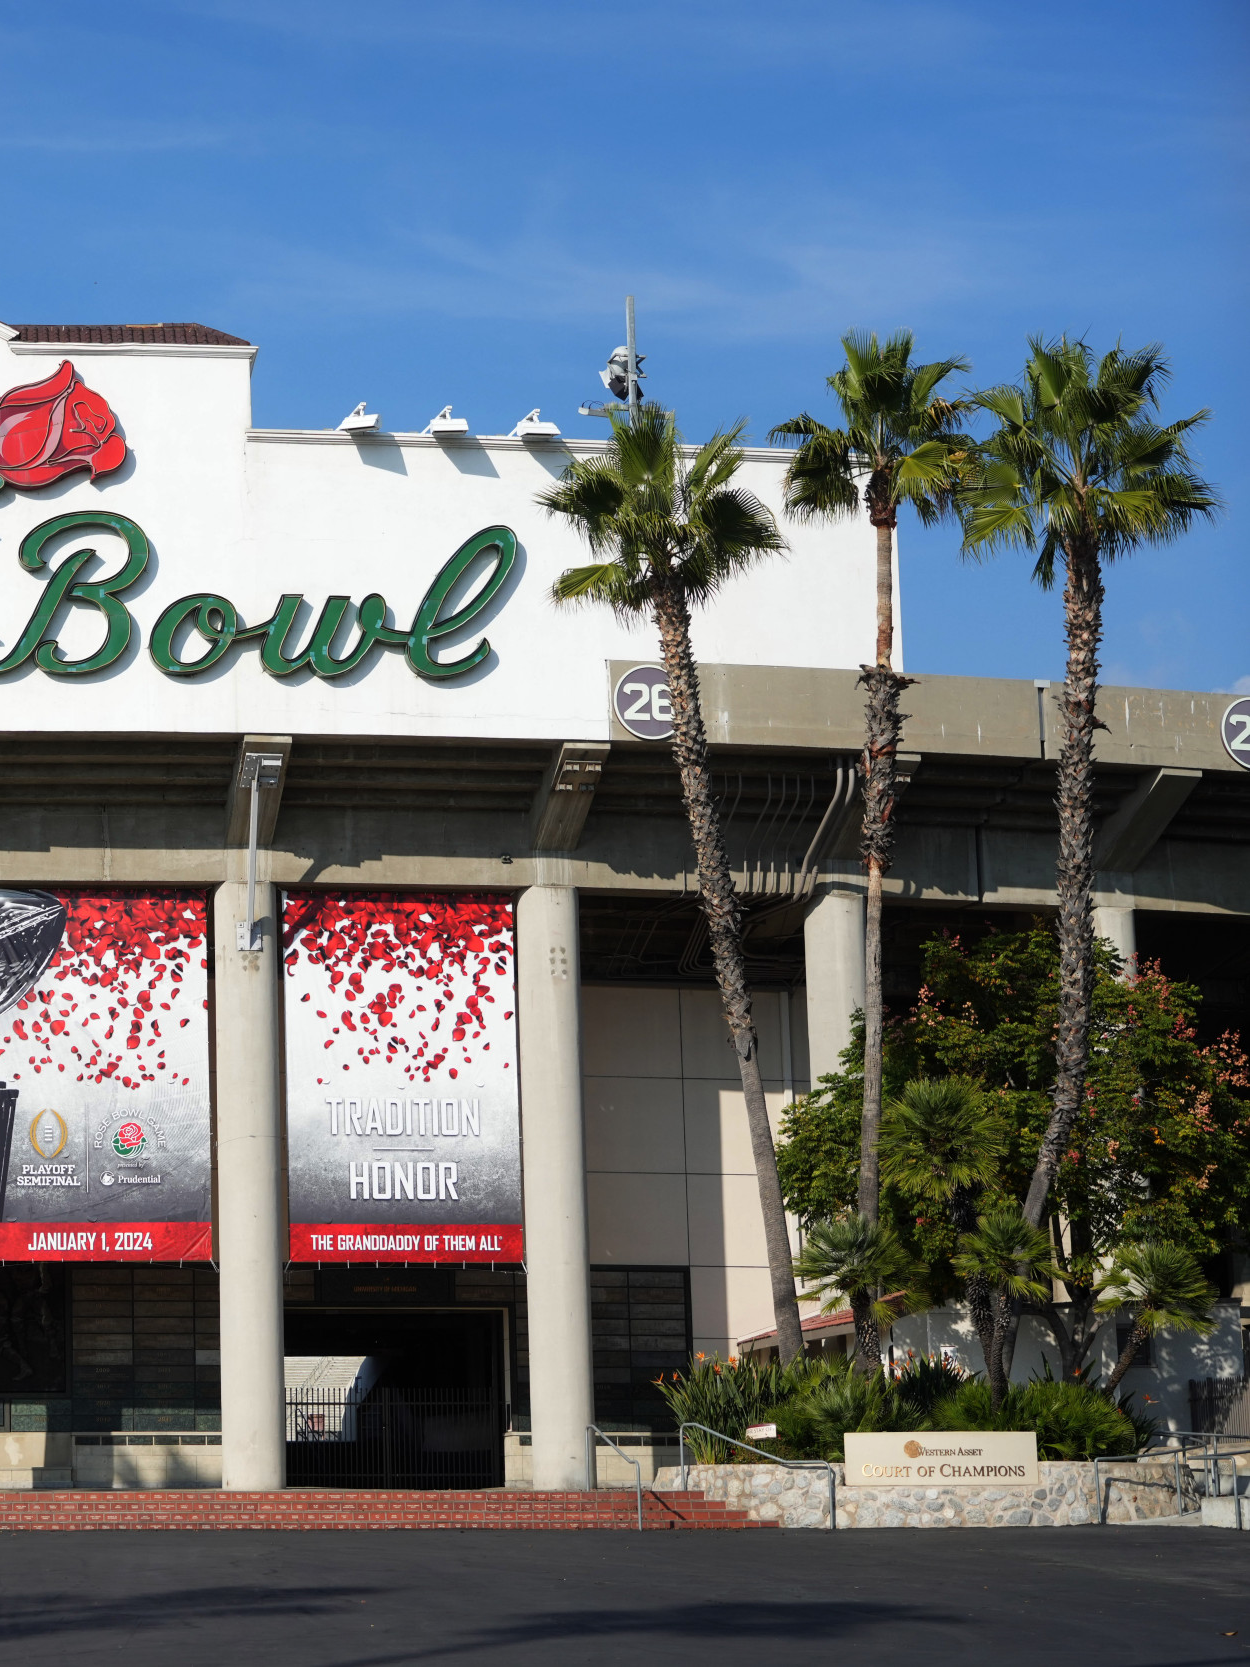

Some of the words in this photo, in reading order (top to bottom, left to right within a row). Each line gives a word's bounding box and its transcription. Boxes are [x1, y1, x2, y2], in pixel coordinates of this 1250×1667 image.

[623, 683, 676, 721] 26
[1230, 714, 1250, 750] 2
[326, 1098, 480, 1136] TRADITION
[94, 1118, 111, 1149] ROSE
[111, 1108, 145, 1120] BOWL
[147, 1116, 166, 1148] GAME
[22, 1164, 75, 1175] PLAYOFF
[17, 1176, 80, 1186] SEMIFINAL
[118, 1174, 161, 1184] Prudential
[350, 1162, 458, 1200] HONOR
[28, 1232, 97, 1251] JANUARY
[101, 1232, 110, 1252] 1,
[114, 1232, 153, 1250] 2024
[310, 1235, 333, 1251] THE
[337, 1235, 420, 1251] GRANDDADDY
[424, 1235, 439, 1251] OF
[443, 1235, 476, 1251] THEM
[917, 1446, 956, 1457] WESTERN
[957, 1447, 983, 1457] ASSET
[862, 1463, 912, 1478] COURT
[917, 1466, 936, 1478] OF
[940, 1464, 1026, 1478] CHAMPIONS
